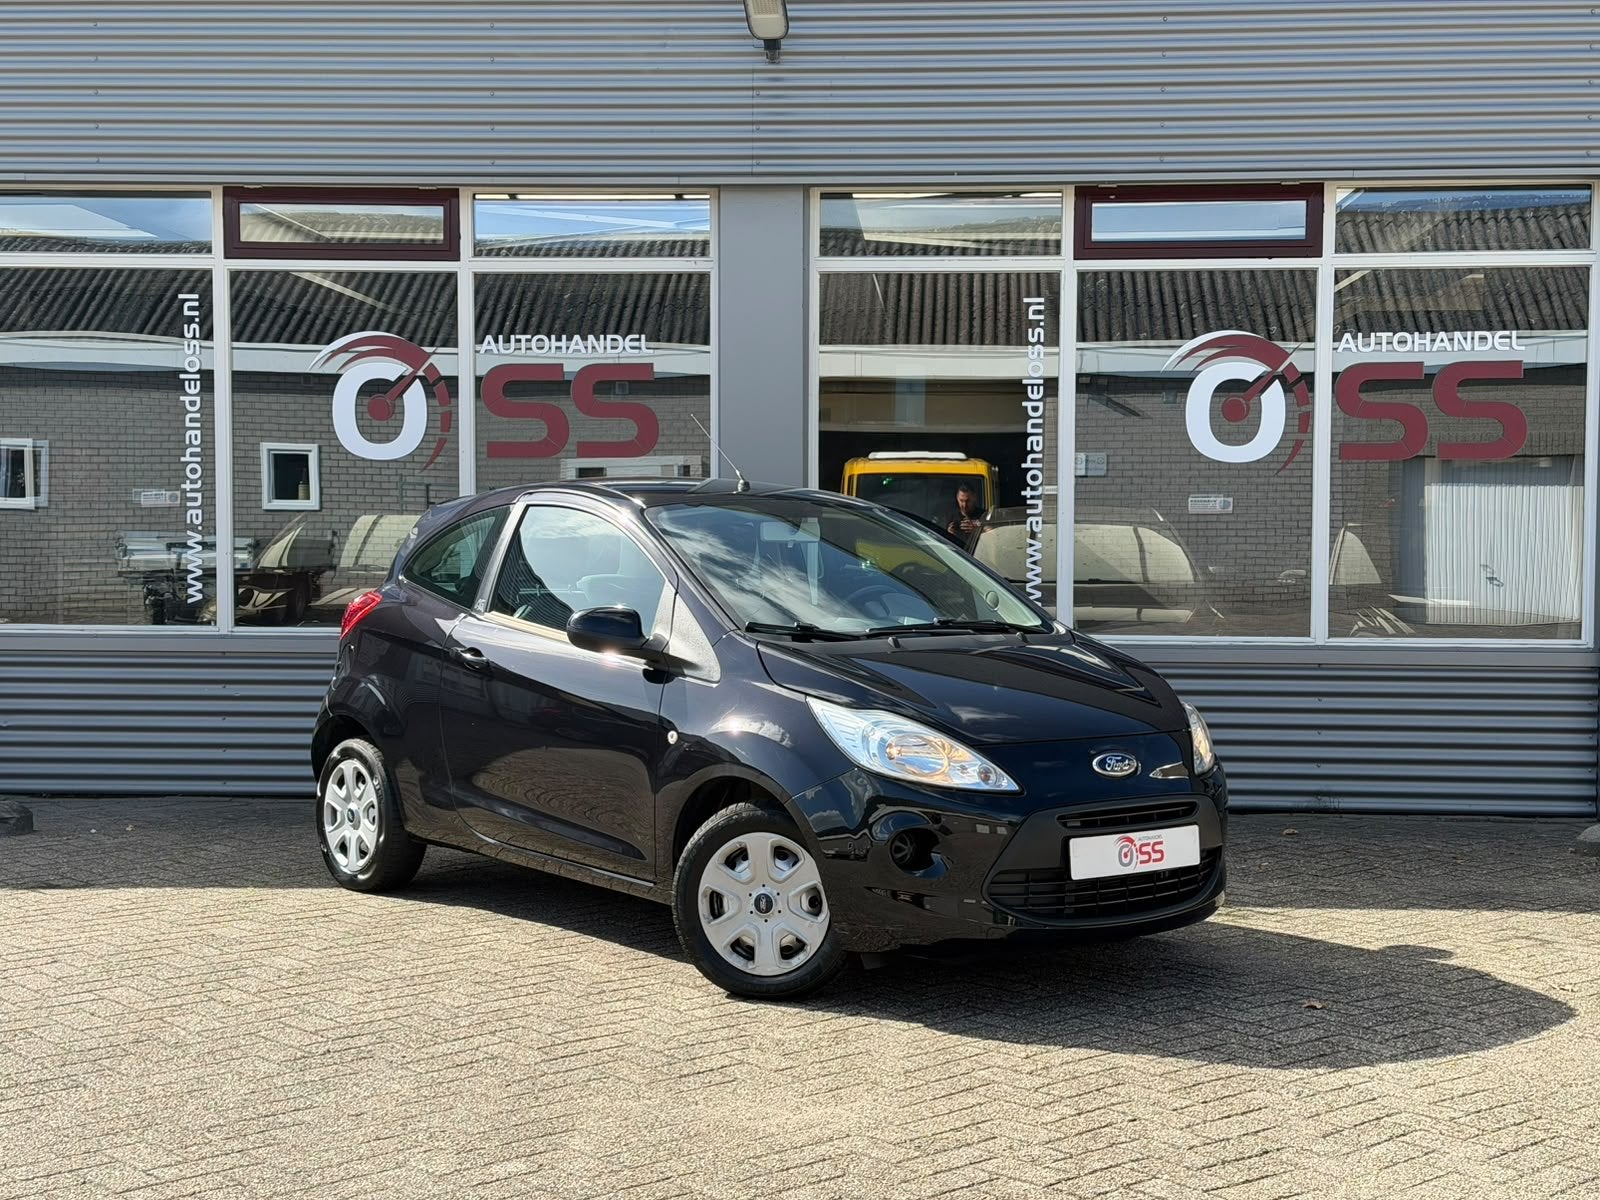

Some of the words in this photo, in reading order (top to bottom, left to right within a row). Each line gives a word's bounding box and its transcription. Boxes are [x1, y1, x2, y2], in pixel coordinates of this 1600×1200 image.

[480, 334, 654, 354] AUTOHANDEL
[1336, 331, 1526, 353] AUTOHANDEL
[178, 294, 203, 604] www.autohandeloss.nl
[1105, 756, 1130, 771] Ford
